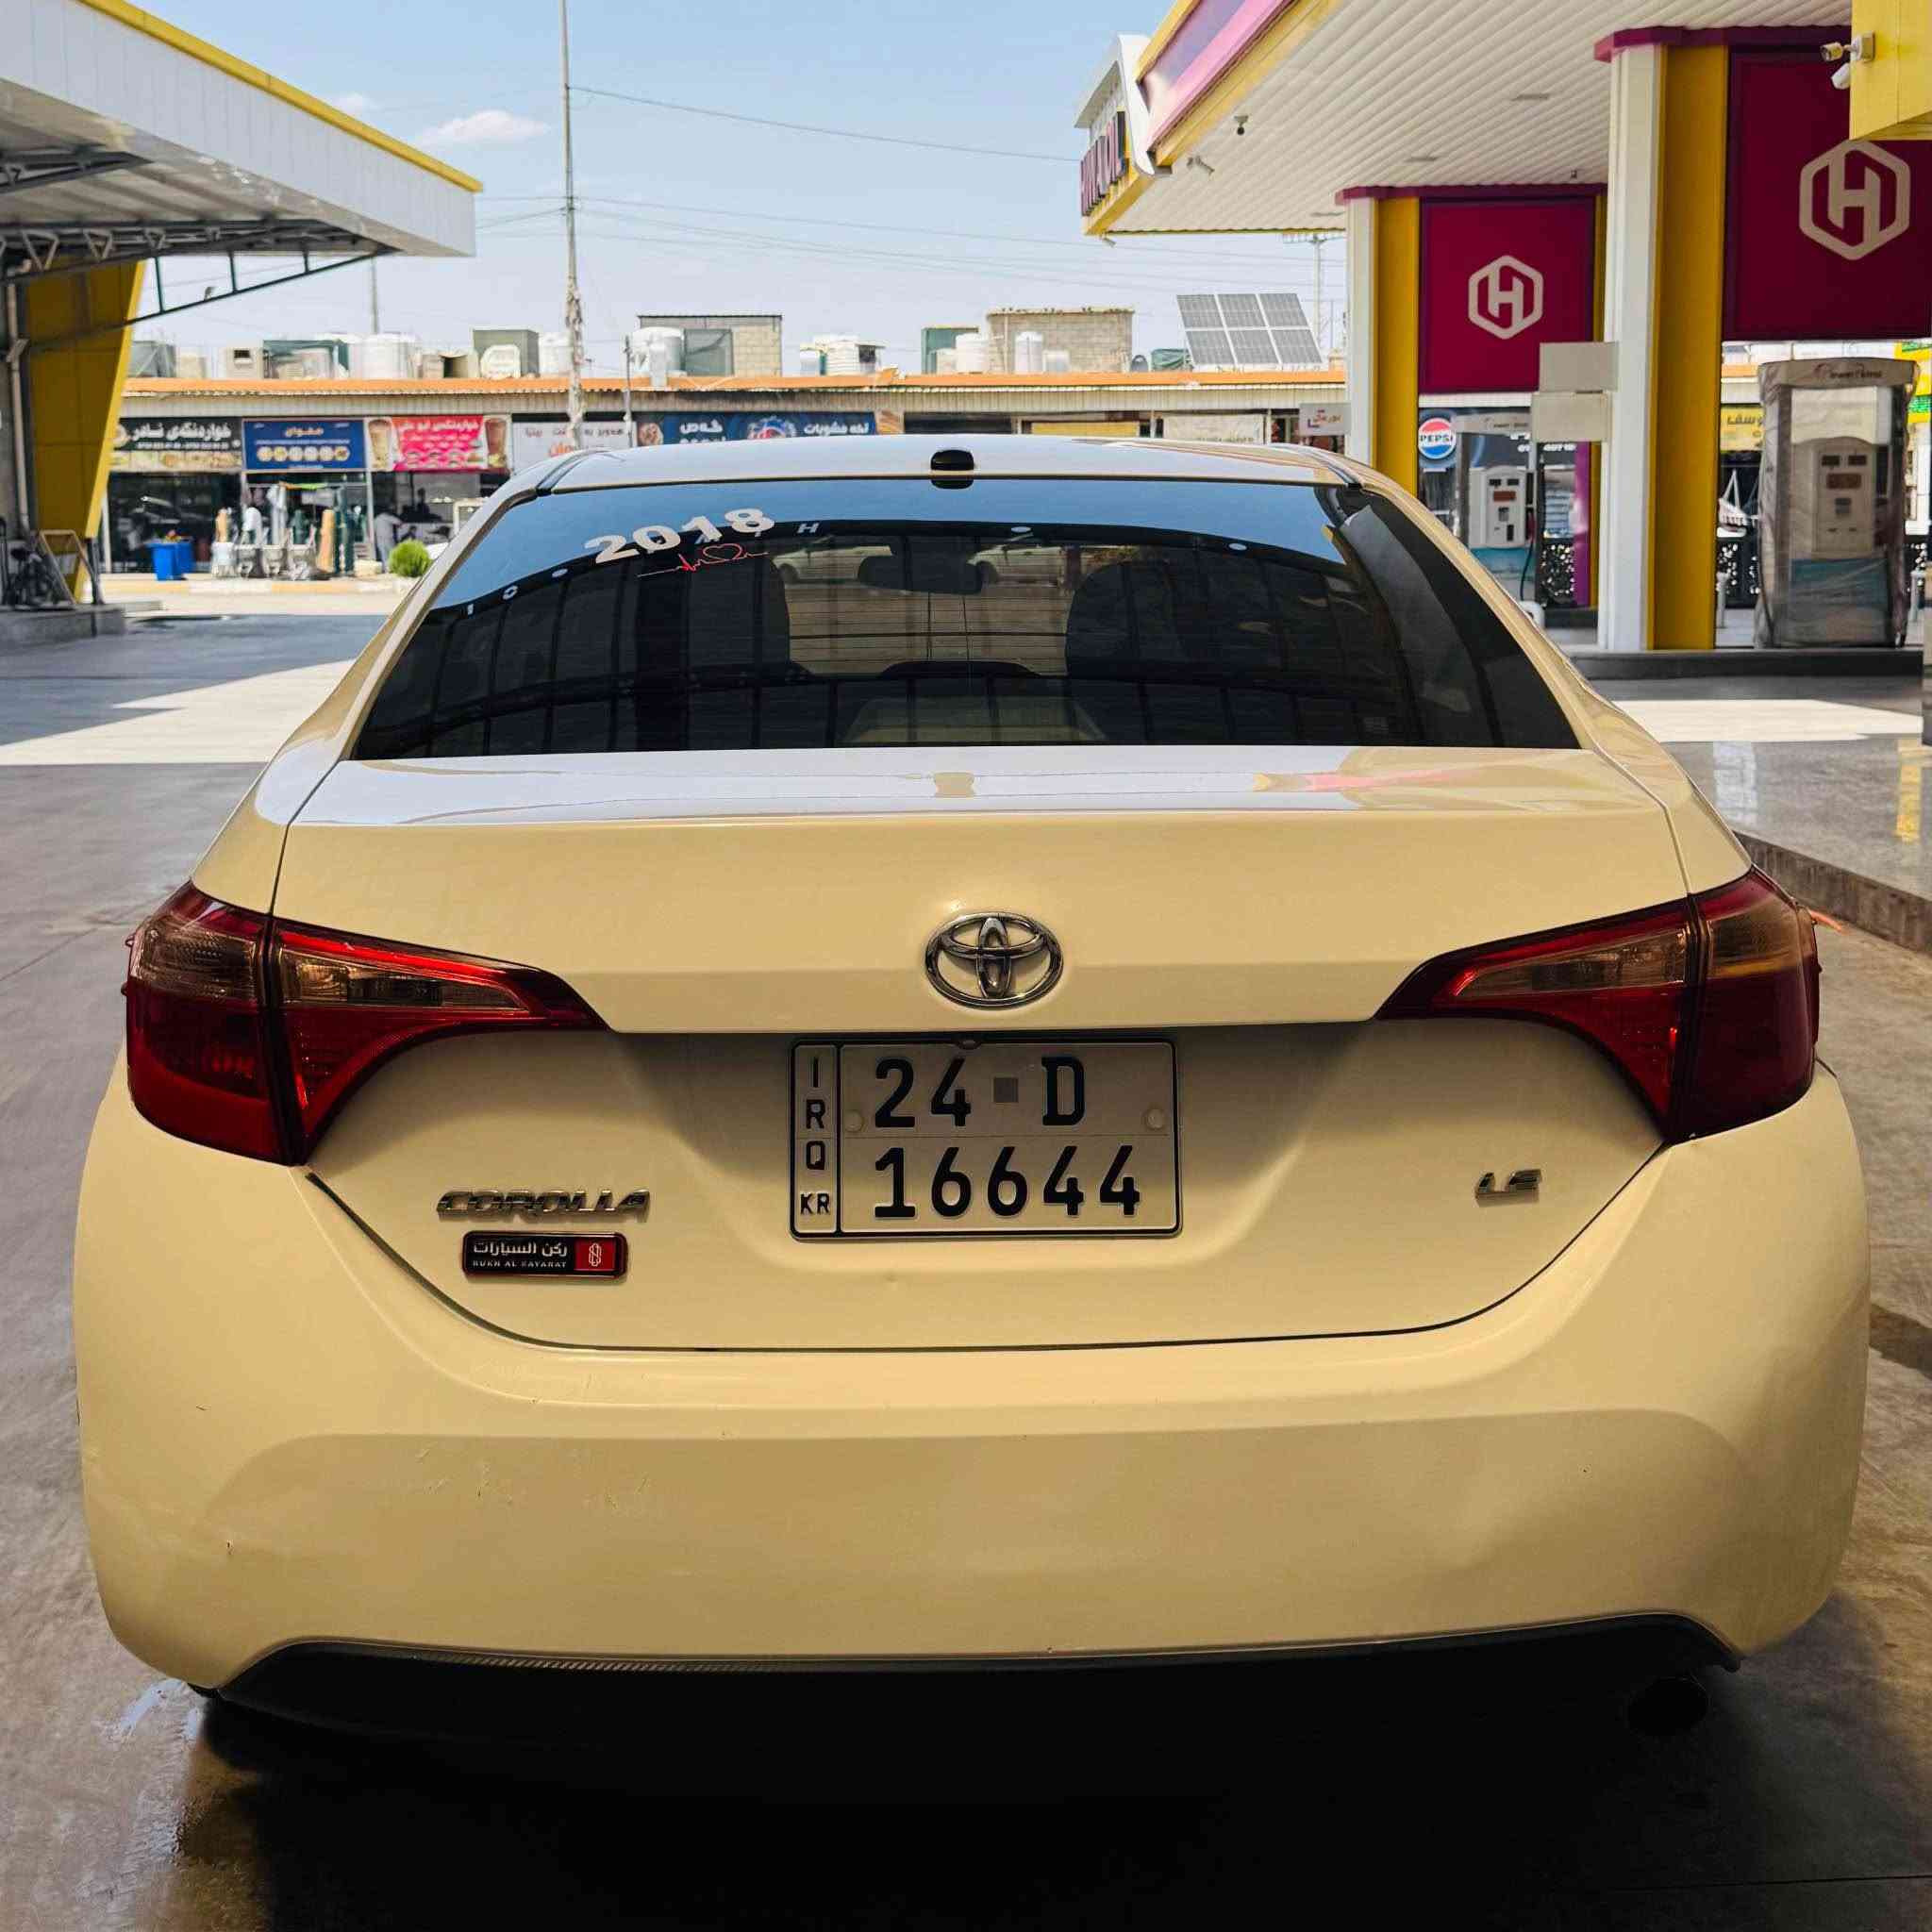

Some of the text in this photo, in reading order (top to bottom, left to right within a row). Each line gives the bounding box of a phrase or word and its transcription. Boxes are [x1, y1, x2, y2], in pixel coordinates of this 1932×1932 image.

[1420, 433, 1453, 442] PEPSI
[584, 508, 775, 564] 2018
[874, 1056, 1086, 1127] 24 D
[874, 1144, 1141, 1219] 16644
[437, 1189, 651, 1215] COROLLA
[800, 1192, 830, 1215] KR
[474, 1241, 568, 1257] ركن السيارات
